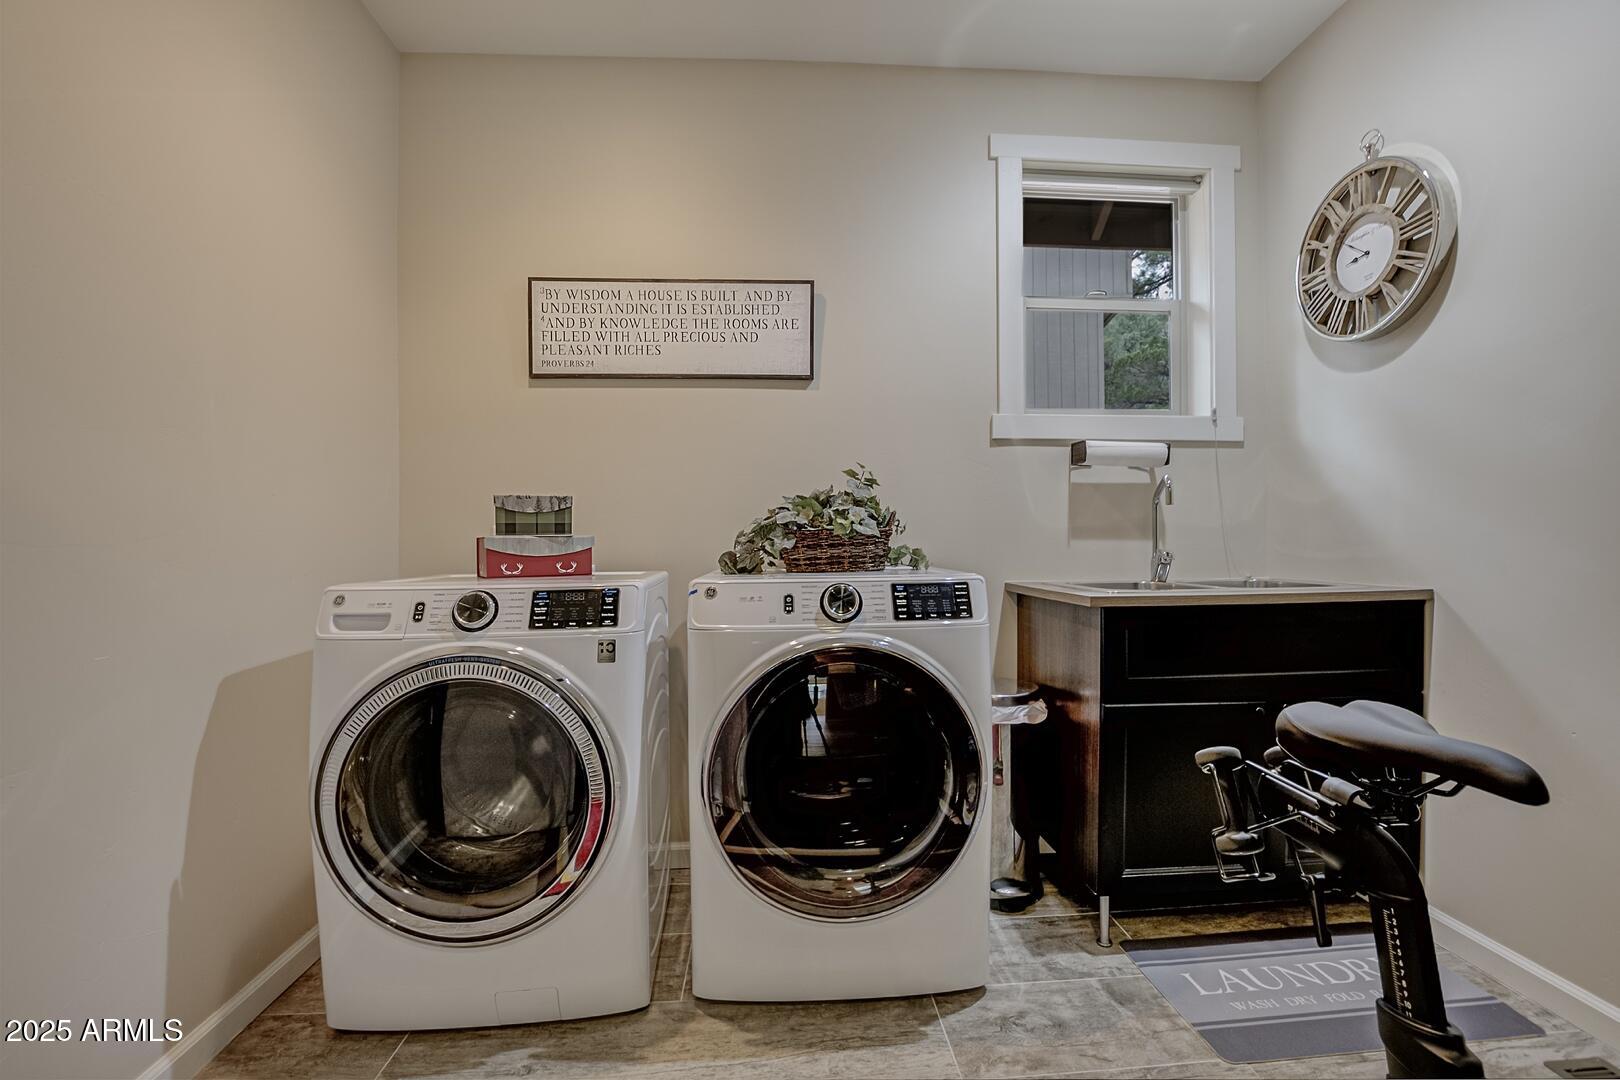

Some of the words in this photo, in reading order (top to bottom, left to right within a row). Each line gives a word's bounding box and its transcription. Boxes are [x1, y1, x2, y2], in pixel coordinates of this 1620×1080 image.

[566, 289, 621, 301] WISDOM
[626, 290, 634, 301] A
[638, 289, 682, 301] HOUSE
[687, 290, 697, 302] IS
[701, 290, 738, 302] BUILT
[744, 290, 773, 302] AND
[777, 290, 793, 302] BY
[541, 302, 658, 315] UNDERSTANDING
[661, 303, 673, 315] IT
[677, 303, 687, 315] IS
[579, 317, 595, 329] BY
[600, 317, 688, 330] KNOWLEDGE
[692, 318, 719, 330] THE
[723, 318, 768, 330] ROOMS
[772, 318, 800, 330] ARE
[541, 330, 591, 342] FILLED
[595, 330, 630, 342] WITH
[635, 331, 660, 343] ALL
[663, 331, 726, 343] PRECIOUS
[730, 331, 759, 343] AND
[541, 344, 610, 356] PLEASANT
[614, 344, 662, 356] RICHES
[541, 360, 585, 368] PROVERBS
[585, 360, 594, 368] 24
[1391, 918, 1397, 926] 2
[1229, 999, 1280, 1011] WASH
[1283, 994, 1319, 1006] DRY
[1323, 991, 1366, 1003] FOLD
